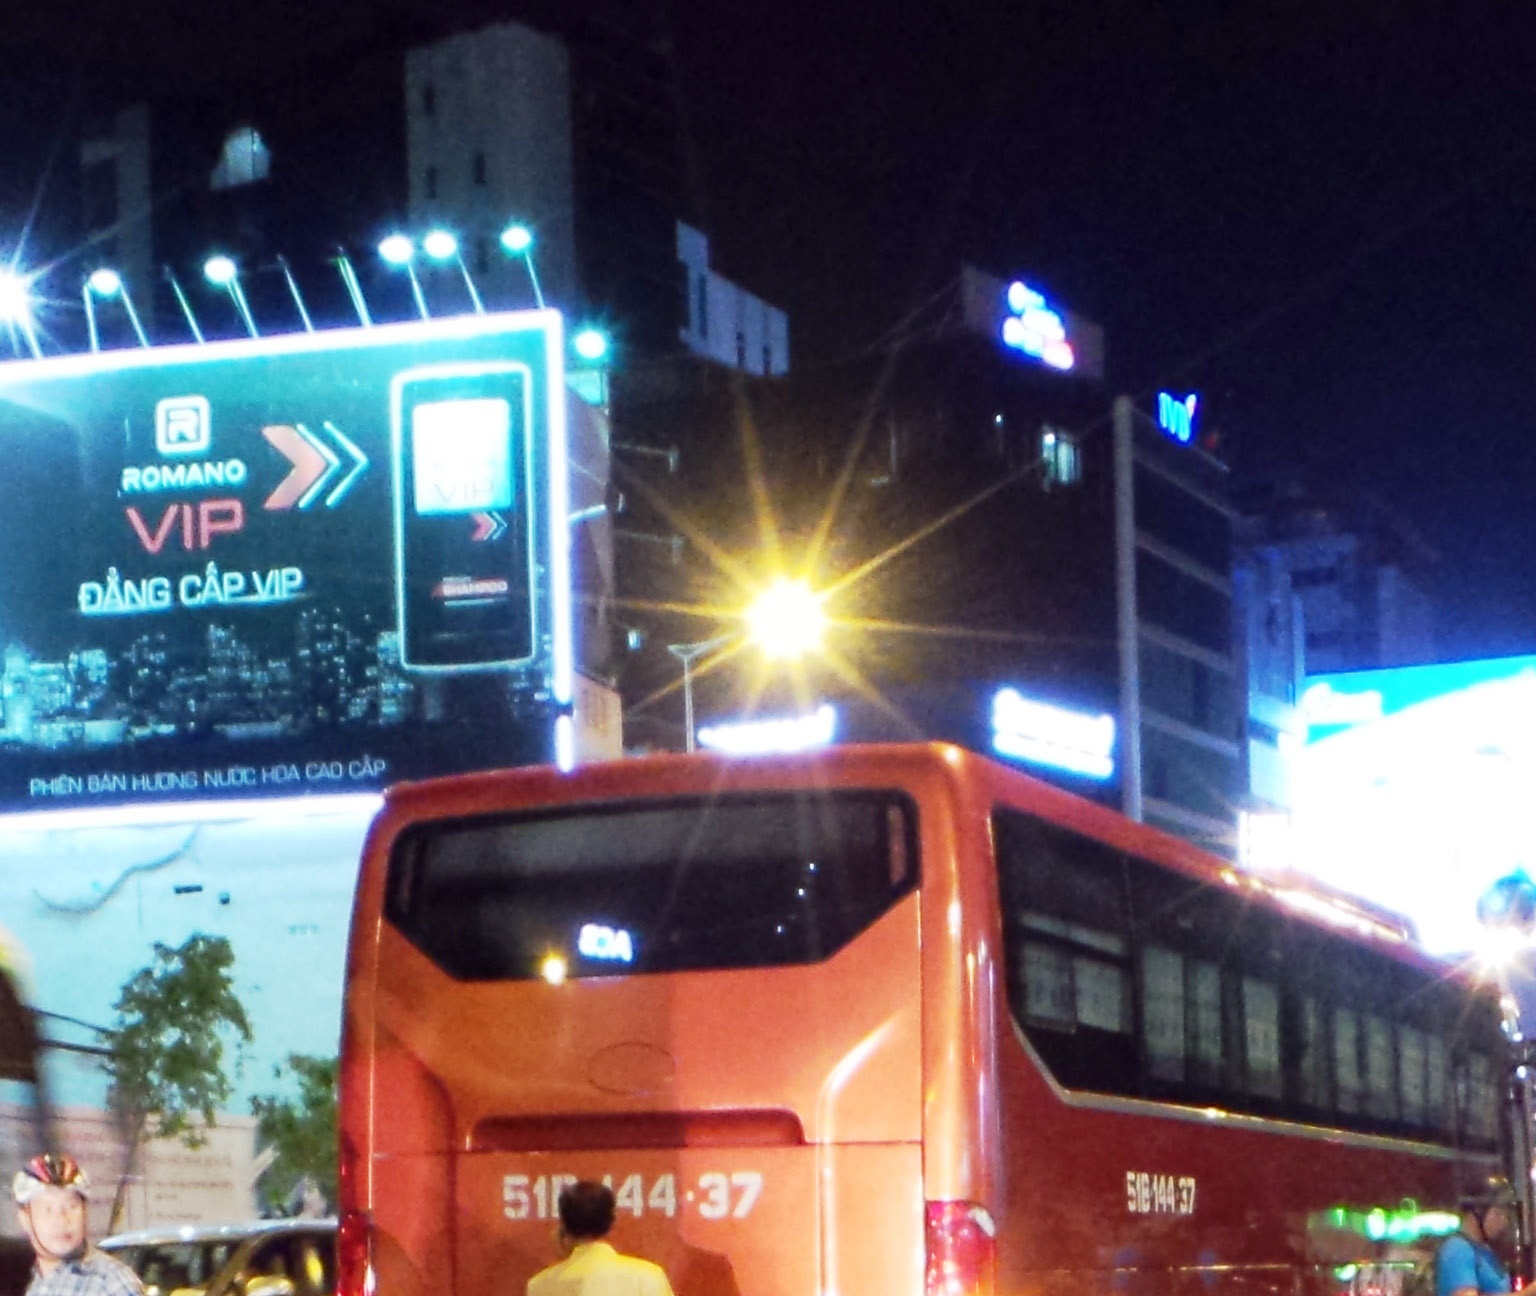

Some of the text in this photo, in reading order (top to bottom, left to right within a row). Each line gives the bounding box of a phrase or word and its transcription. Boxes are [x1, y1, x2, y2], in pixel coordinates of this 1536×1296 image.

[121, 458, 246, 492] ROMANO
[125, 499, 244, 554] VIP
[78, 560, 304, 616] ĐẲNG CẤP VIP
[261, 762, 301, 785] HOA
[305, 759, 343, 781] CAO
